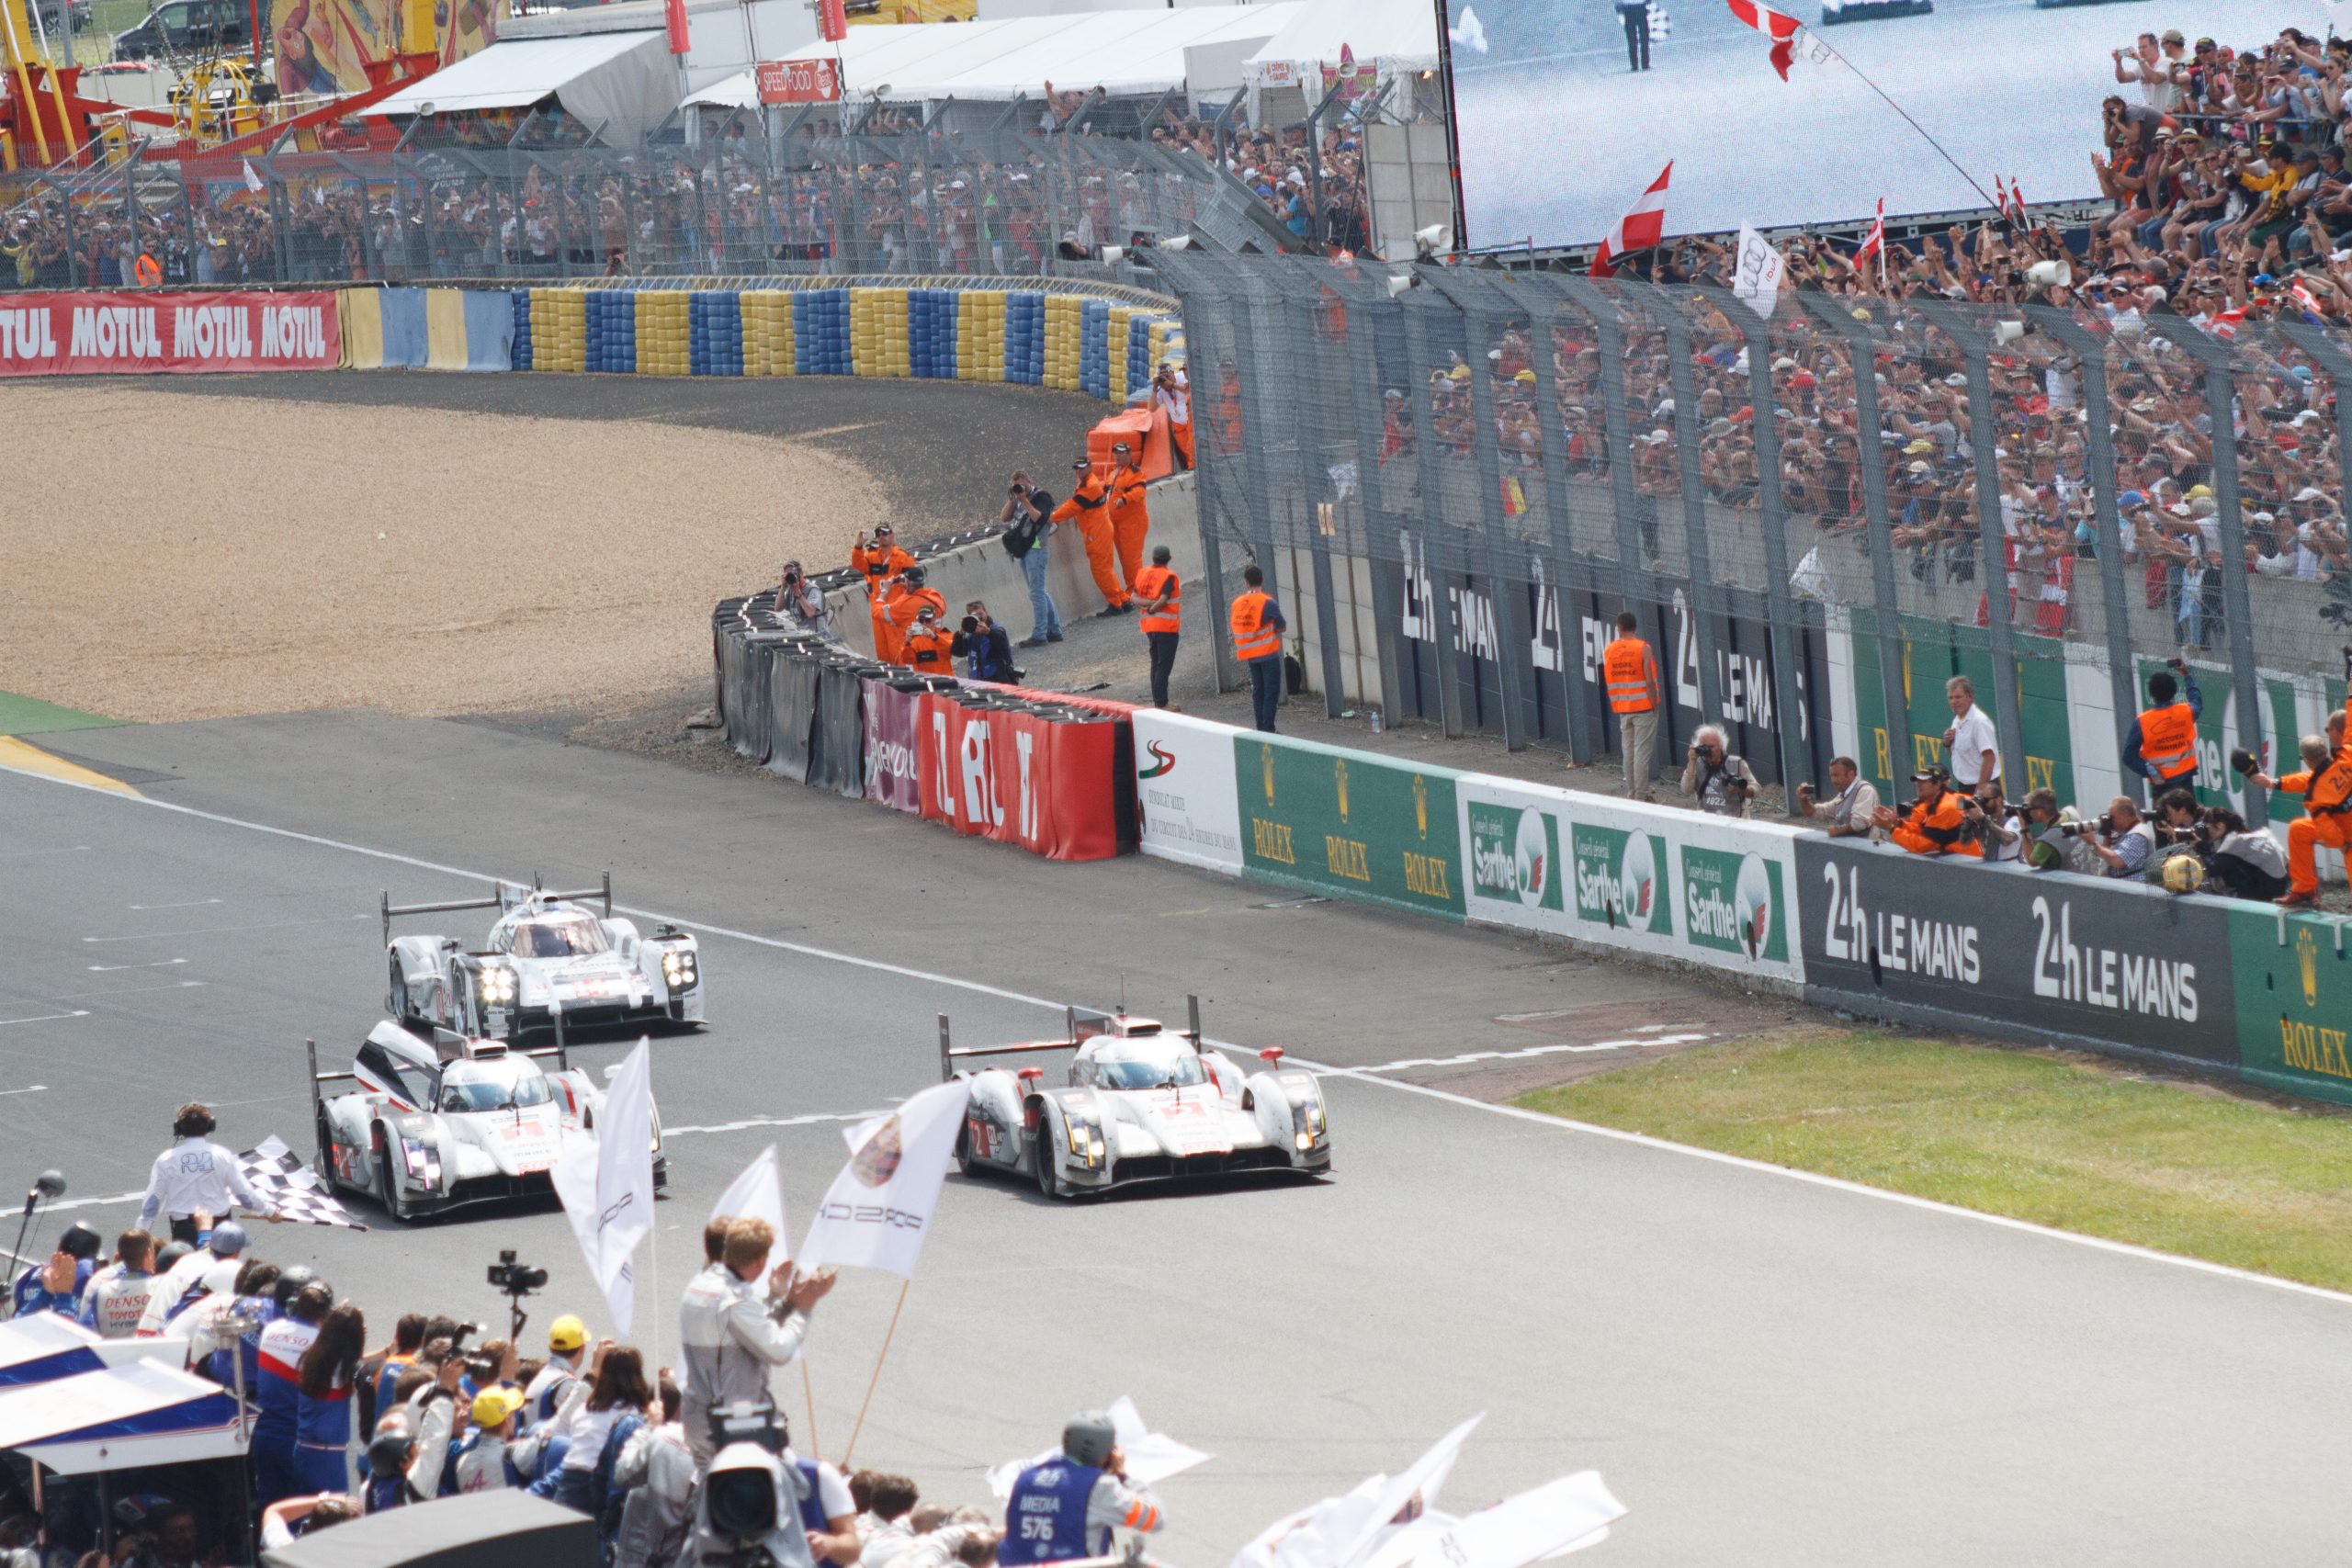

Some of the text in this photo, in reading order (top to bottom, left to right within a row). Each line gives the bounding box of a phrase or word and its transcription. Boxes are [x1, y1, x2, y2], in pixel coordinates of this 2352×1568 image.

[763, 71, 786, 92] SPEED
[787, 71, 811, 91] FOOD
[0, 308, 57, 359] TUL
[70, 307, 162, 358] MOTUL
[174, 306, 253, 359] MOTUL
[260, 306, 326, 358] MOTUL
[1252, 817, 1296, 865] ROLEX
[1326, 835, 1372, 883] ROLEX
[1475, 836, 1515, 891] Sarthe
[1403, 852, 1451, 900] ROLEX
[1578, 859, 1622, 915] Sarthe
[1689, 882, 1736, 941] Sarthe
[1824, 861, 1980, 984] 24h LE MANS
[2032, 896, 2199, 1022] 24h LE MANS
[2279, 1019, 2352, 1079] ROLEX
[105, 1293, 151, 1309] DENSO
[267, 1332, 310, 1347] DENSO
[1019, 1495, 1060, 1513] MEDIA
[1021, 1517, 1054, 1541] 576
